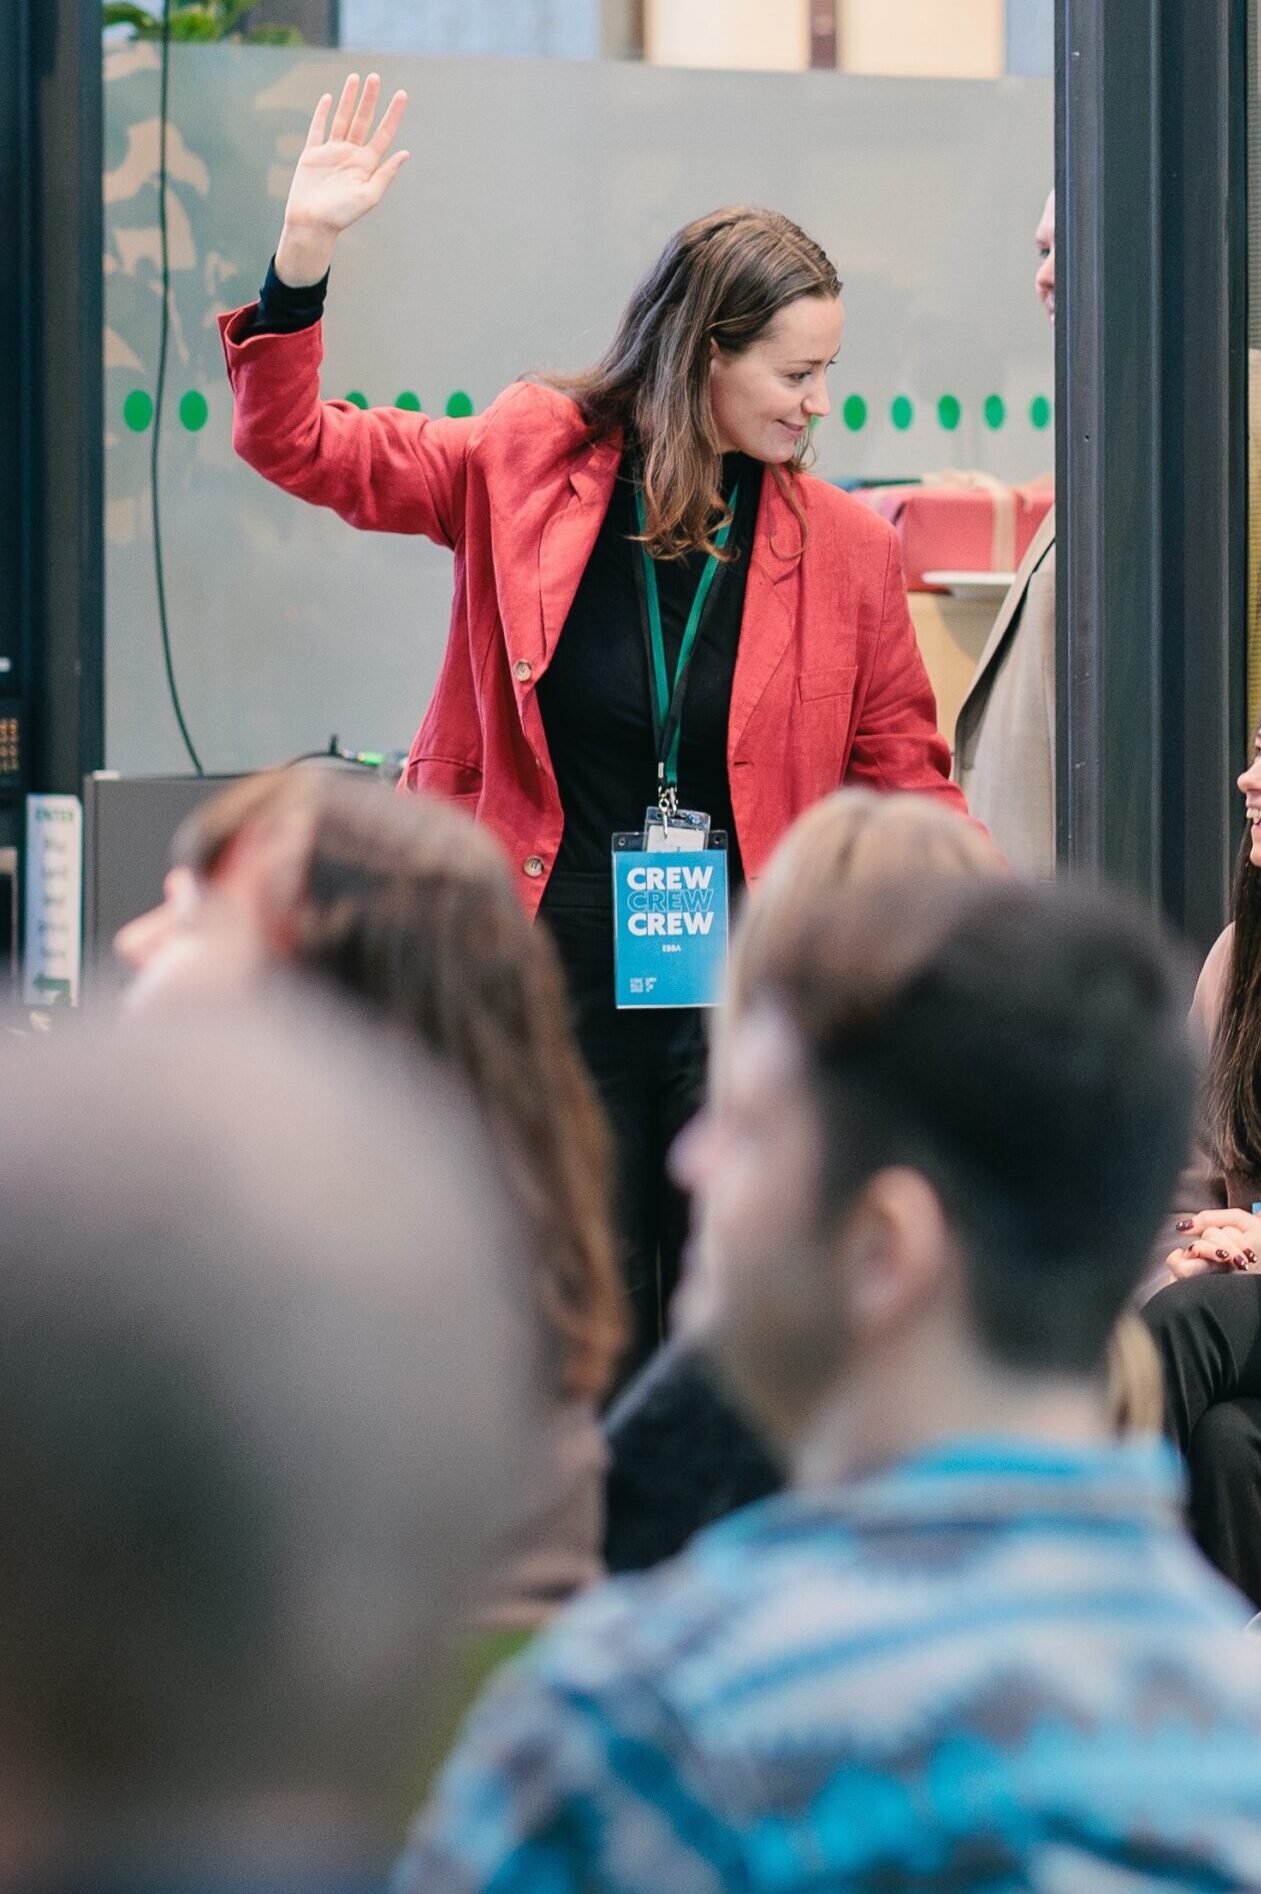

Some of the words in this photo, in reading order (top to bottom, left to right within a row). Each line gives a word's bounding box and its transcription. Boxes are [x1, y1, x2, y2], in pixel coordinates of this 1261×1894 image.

[626, 866, 713, 890] CREW
[627, 889, 714, 912] CREW
[628, 911, 715, 936] CREW
